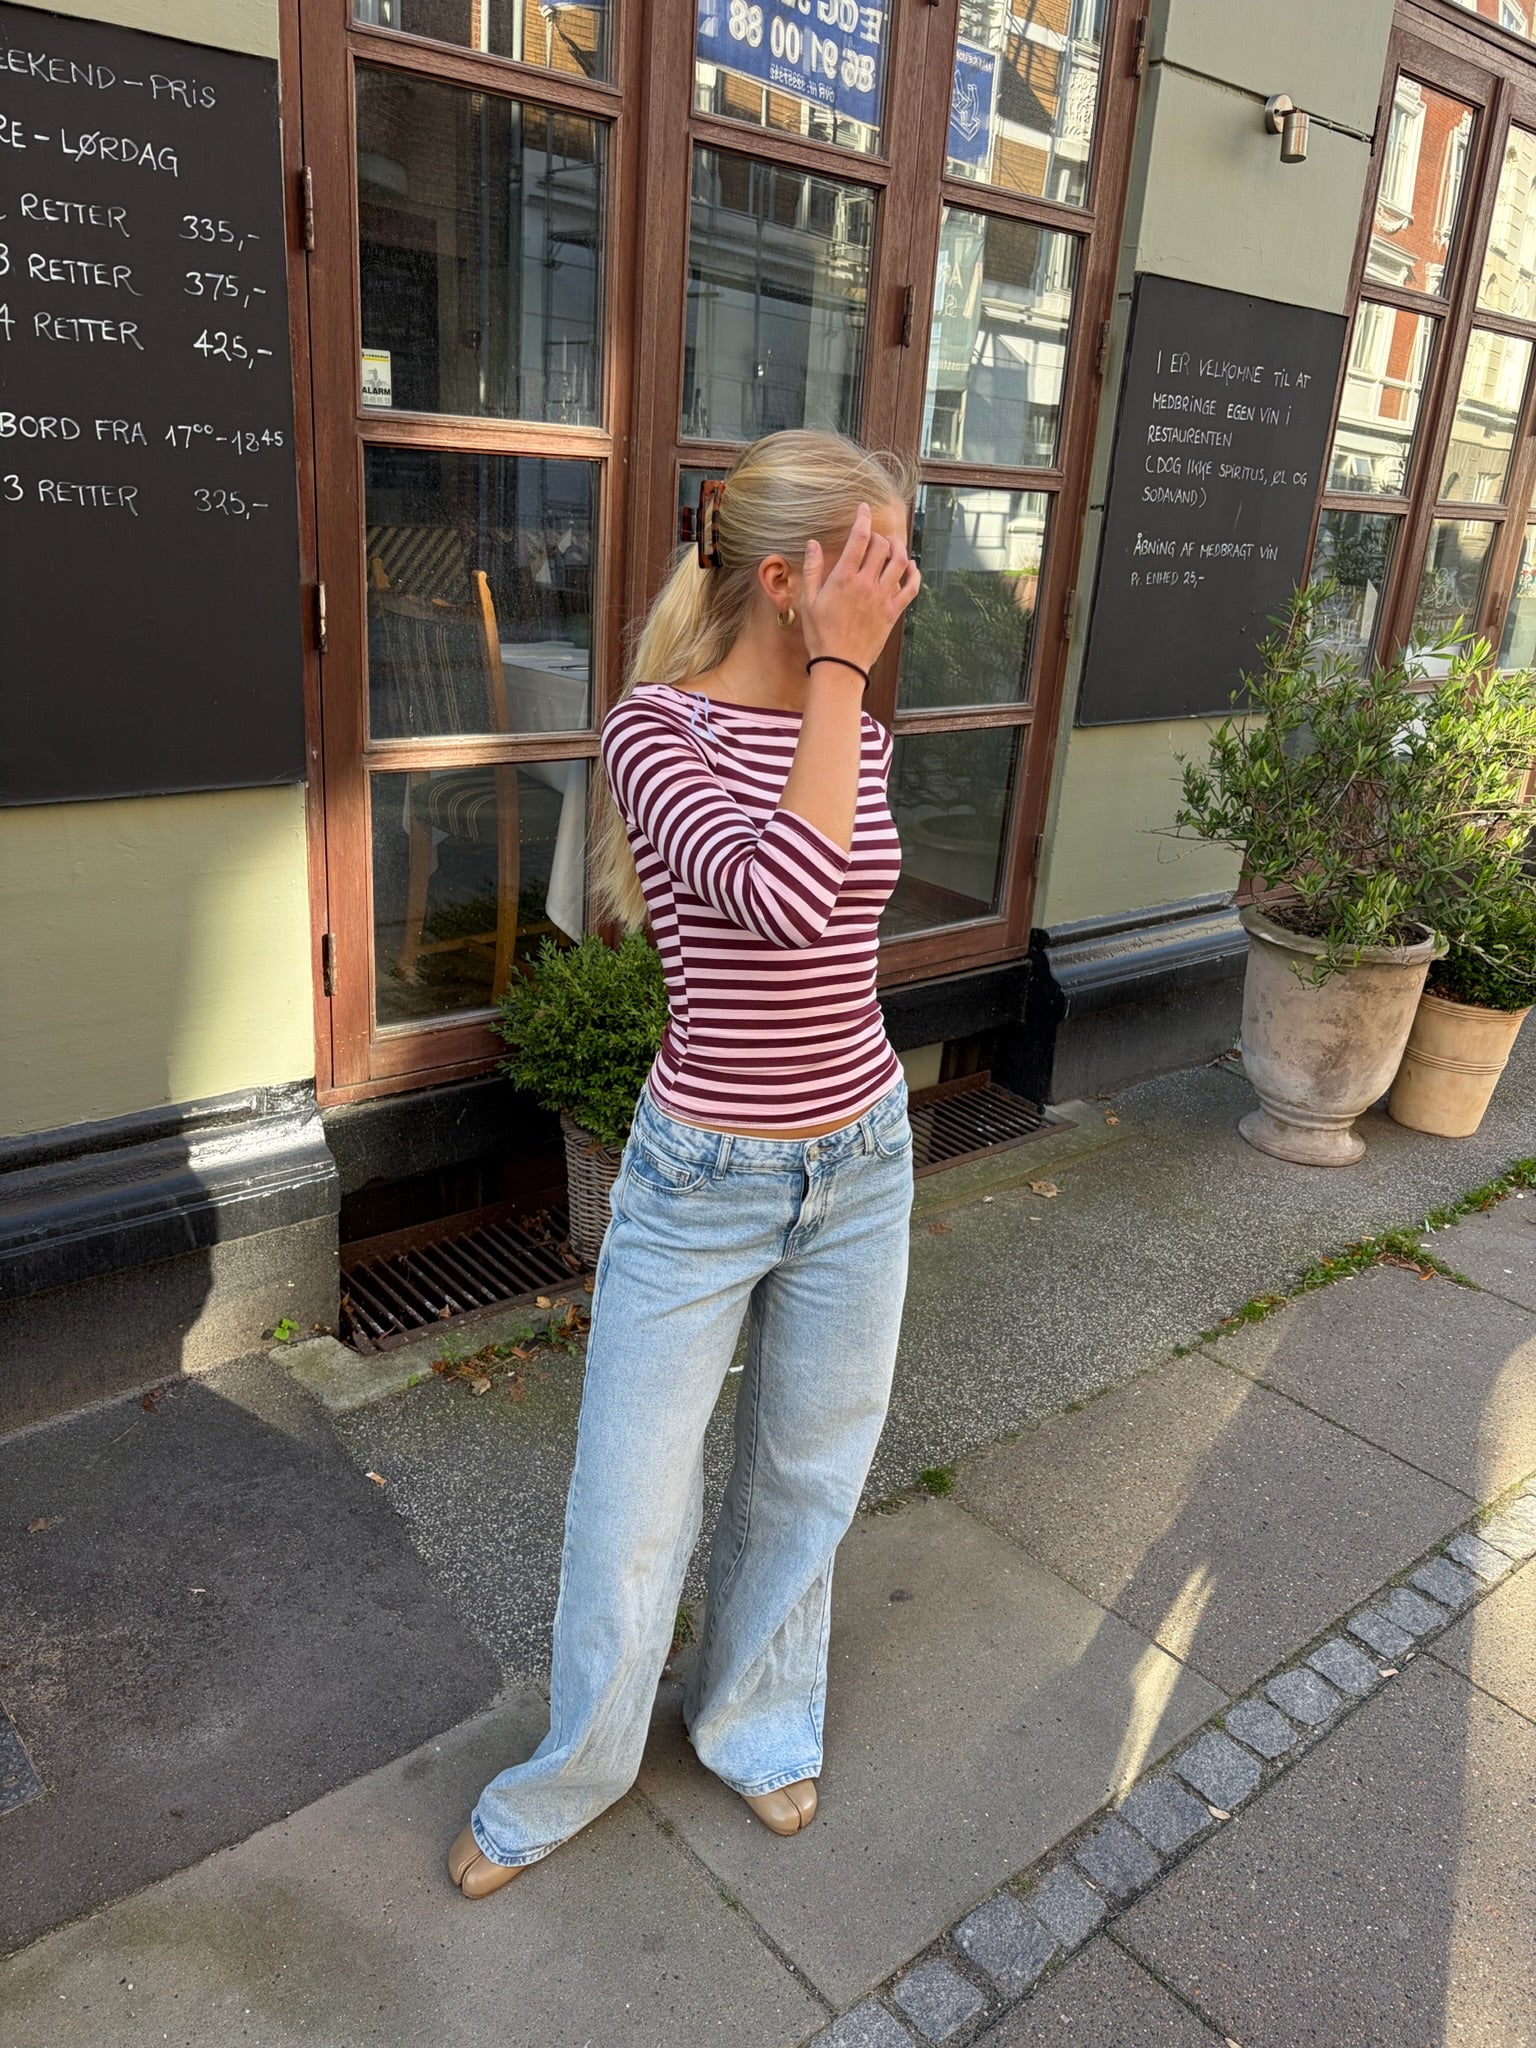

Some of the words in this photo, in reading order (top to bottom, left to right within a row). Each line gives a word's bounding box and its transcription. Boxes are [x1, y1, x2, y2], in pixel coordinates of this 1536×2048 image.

[21, 193, 130, 237] RETTER
[28, 253, 143, 296] RETTER
[184, 271, 266, 308] 375,-
[34, 312, 144, 350] RETTER
[1170, 352, 1190, 376] ER
[1296, 372, 1311, 389] AT
[362, 386, 391, 396] ALARM
[0, 412, 80, 439] BORD
[95, 419, 147, 446] FRA
[1226, 403, 1255, 421] EGEN
[1187, 459, 1212, 480] IKKE
[1293, 472, 1307, 486] OG
[3, 475, 23, 501] 3
[38, 480, 138, 516] RETTER
[1180, 542, 1196, 557] AF
[1200, 543, 1254, 560] MEDBRAGT
[1147, 571, 1179, 585] ENHED
